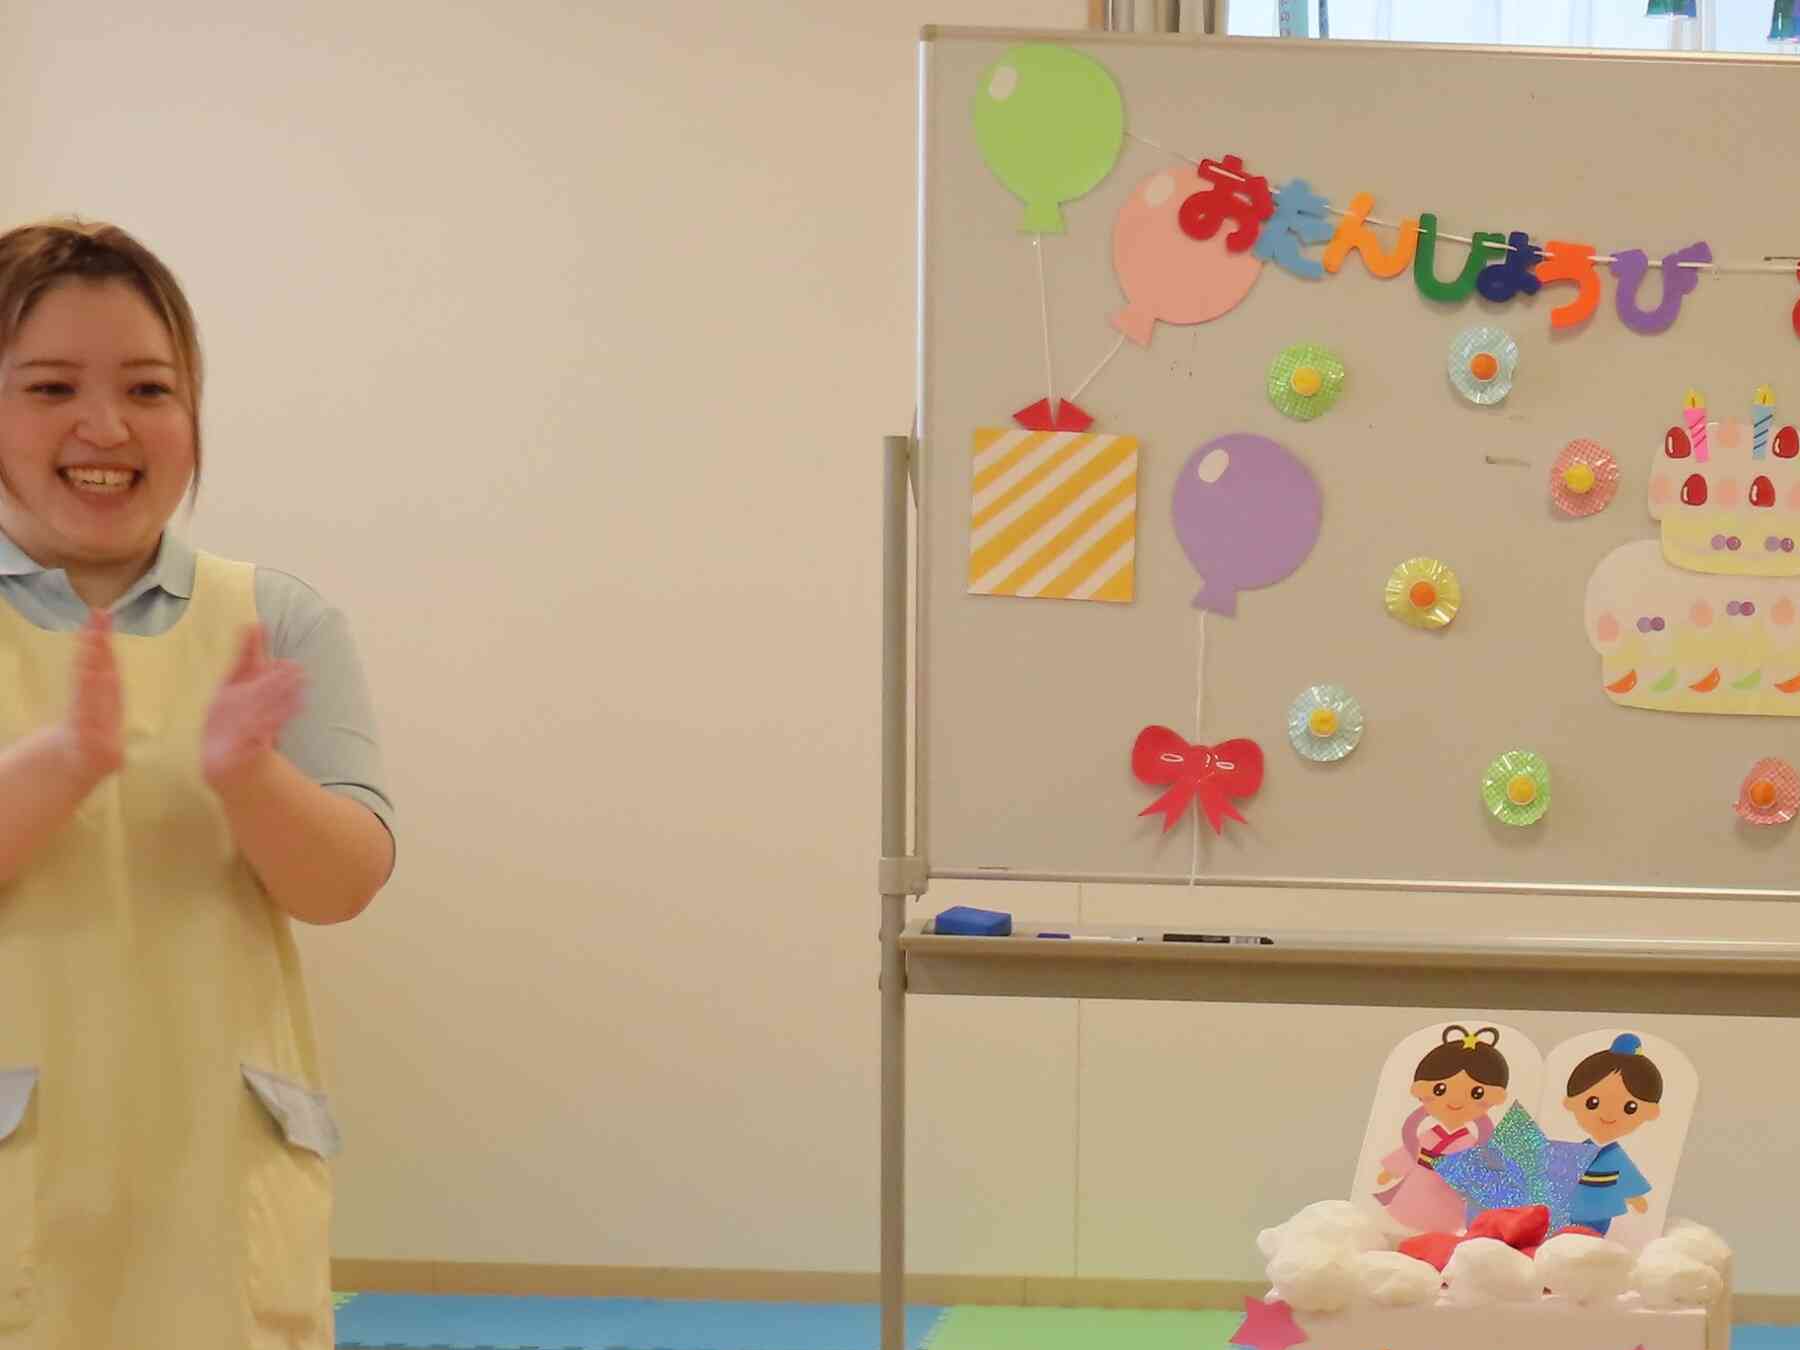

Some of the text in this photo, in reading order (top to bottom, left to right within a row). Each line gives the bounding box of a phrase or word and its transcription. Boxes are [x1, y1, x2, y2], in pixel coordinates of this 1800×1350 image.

[1178, 154, 1714, 335] おたんじょうび
